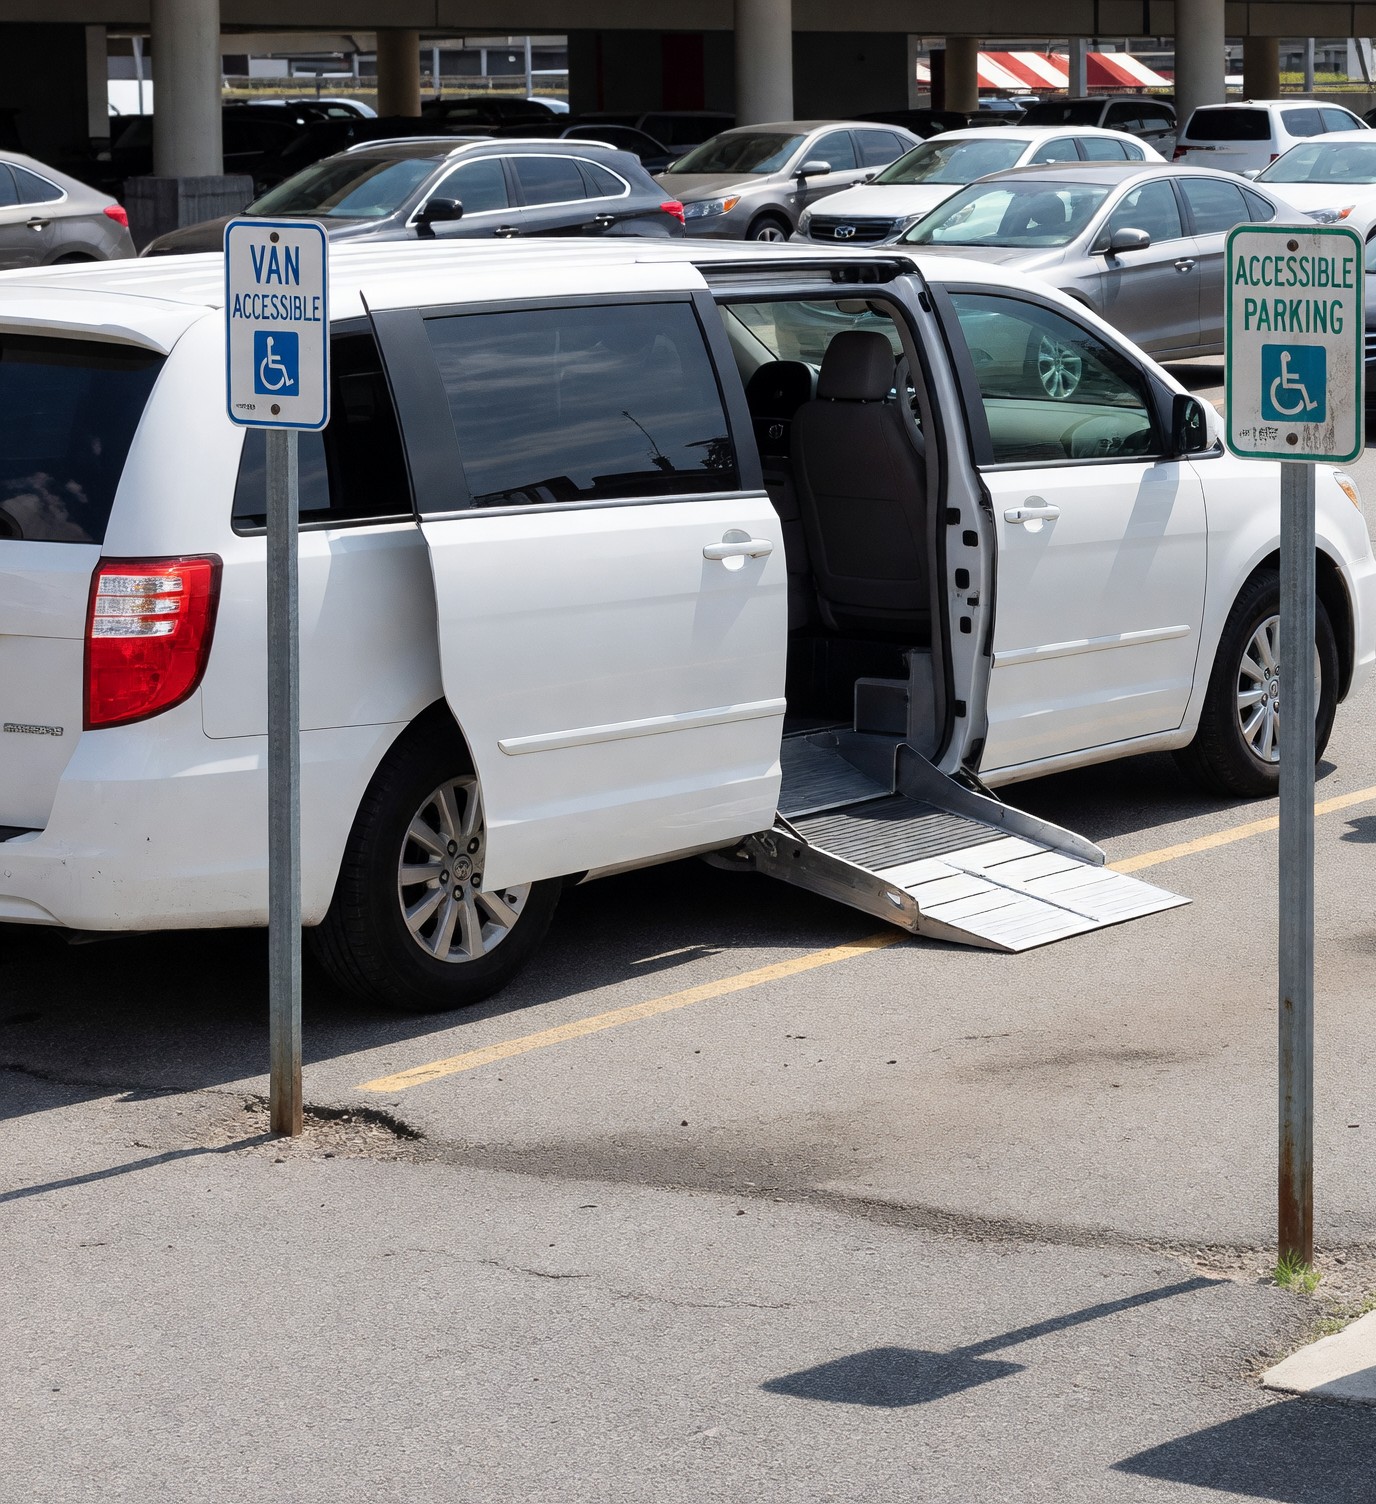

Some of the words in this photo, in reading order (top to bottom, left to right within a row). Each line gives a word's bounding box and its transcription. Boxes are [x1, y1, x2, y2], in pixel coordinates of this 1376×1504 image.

[250, 245, 300, 285] VAN
[1236, 255, 1353, 288] ACCESSIBLE
[233, 294, 320, 321] ACCESSIBLE
[1244, 298, 1343, 334] PARKING
